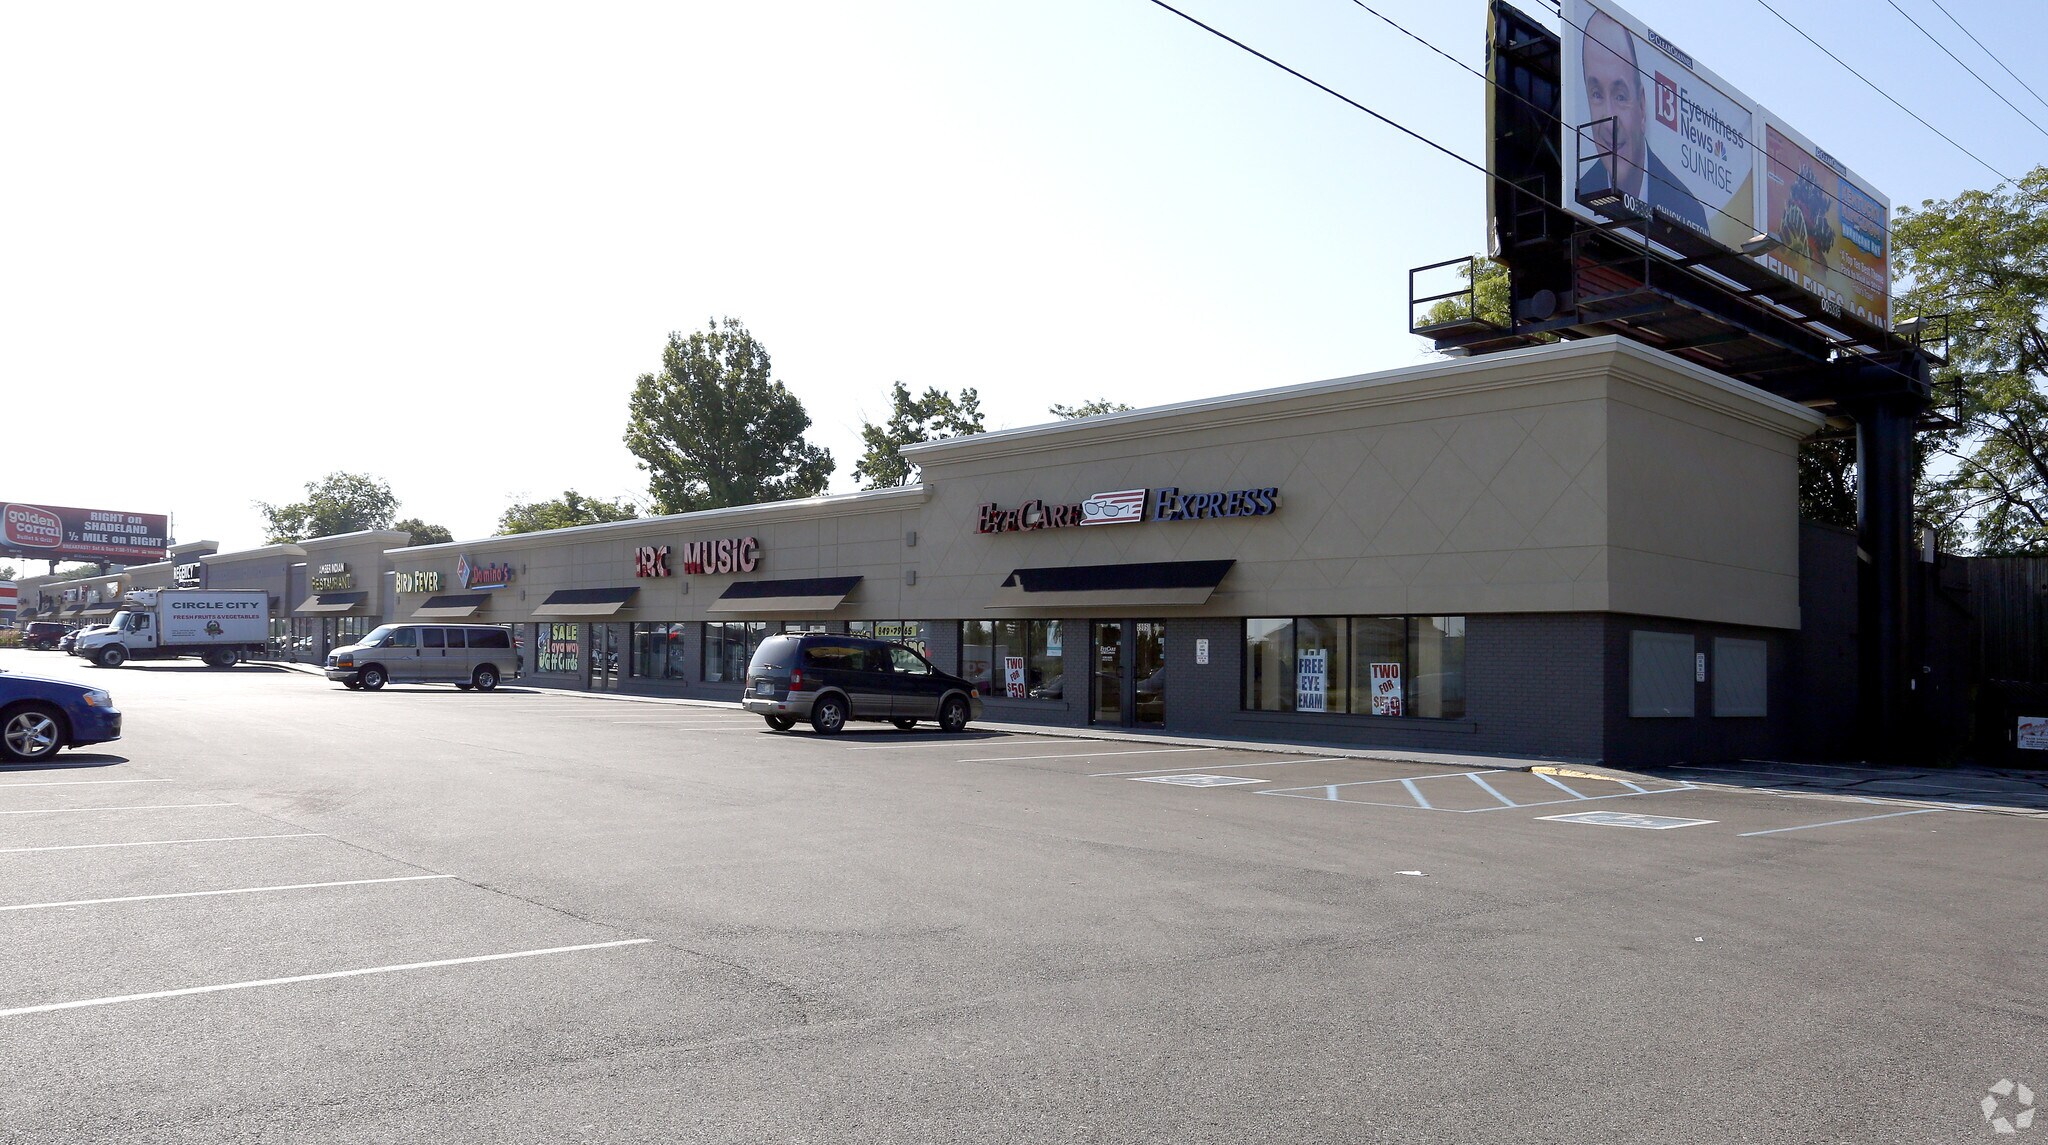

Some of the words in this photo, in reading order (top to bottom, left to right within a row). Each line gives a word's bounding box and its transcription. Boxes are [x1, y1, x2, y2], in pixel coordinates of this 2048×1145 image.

[1656, 81, 1675, 124] 13
[1680, 87, 1745, 149] Eyewitness
[1680, 115, 1713, 153] News
[1680, 144, 1733, 194] SUNRISE
[9, 510, 55, 528] golden
[91, 512, 124, 523] RIGHT
[127, 515, 142, 525] on
[974, 500, 1082, 535] EYECARE
[1151, 487, 1279, 523] EXPRESS
[16, 522, 61, 537] corral
[84, 521, 148, 535] SHADELAND
[82, 532, 108, 544] MILE
[112, 536, 127, 544] on
[130, 536, 162, 547] RIGHT
[684, 537, 759, 575] MUSIC
[473, 562, 511, 583] Domino's
[312, 573, 351, 590] RESTAURANT
[395, 572, 413, 593] BIRD
[414, 570, 439, 593] FEVER
[552, 625, 577, 641] SALE
[546, 639, 579, 659] Layaway
[1006, 657, 1023, 669] TWO
[1299, 658, 1324, 674] FREE
[1371, 664, 1399, 679] TWO
[1009, 669, 1020, 682] FOR
[1301, 675, 1320, 692] EYE
[1007, 682, 1025, 699] $59
[1378, 679, 1395, 695] FOR
[1298, 693, 1323, 709] EXAM
